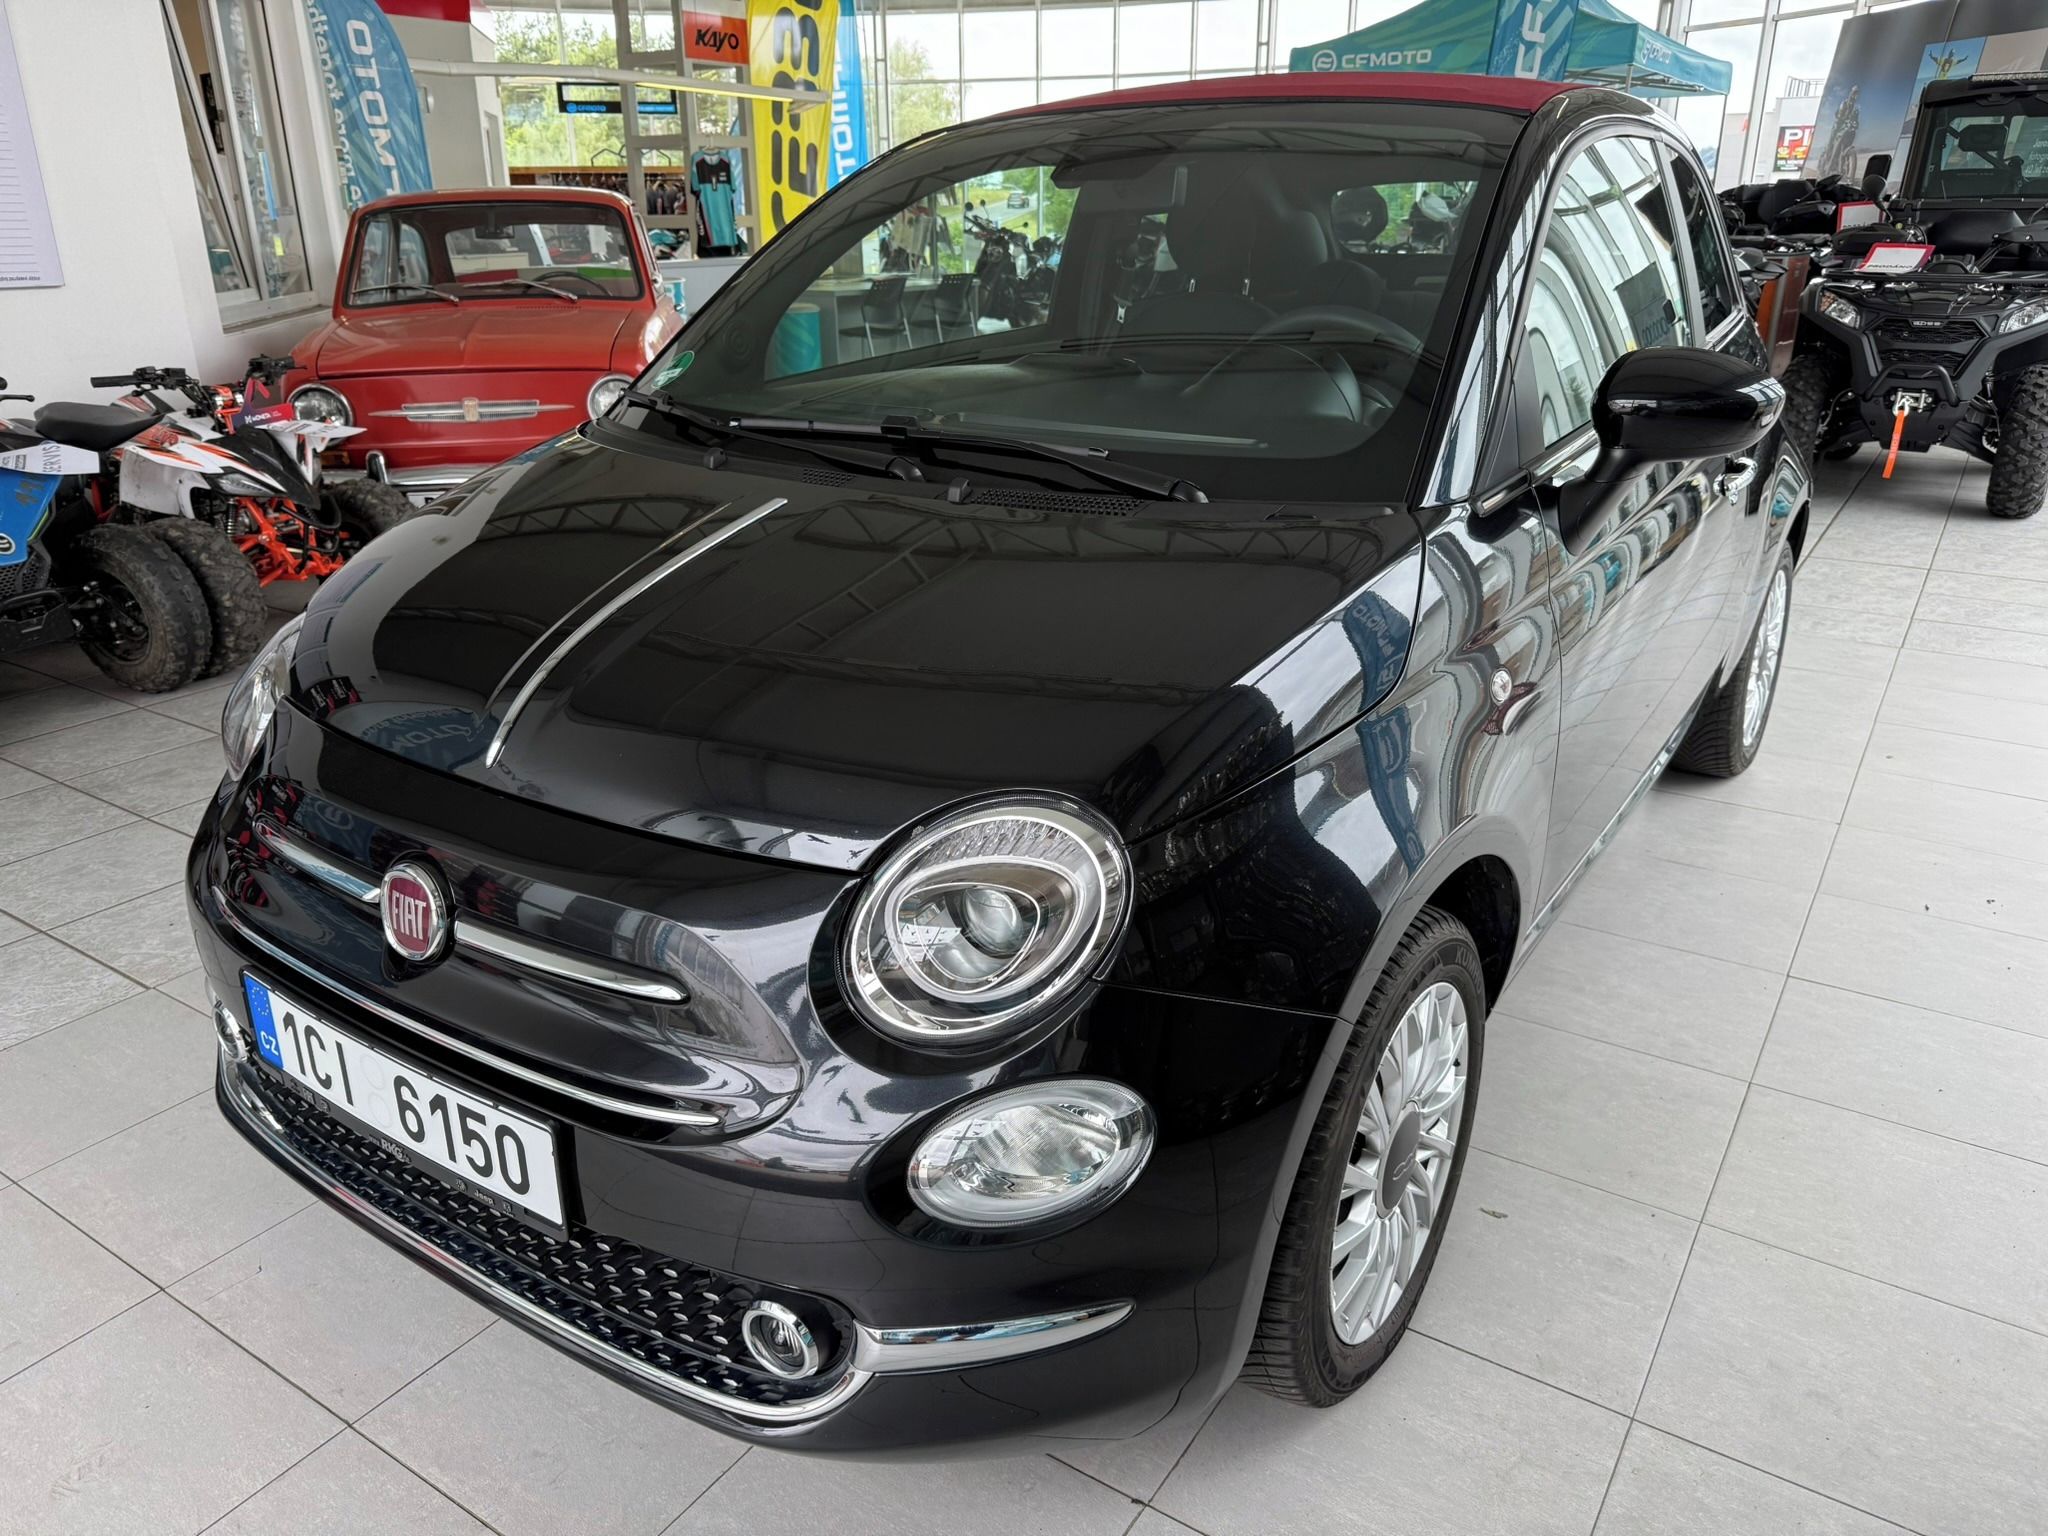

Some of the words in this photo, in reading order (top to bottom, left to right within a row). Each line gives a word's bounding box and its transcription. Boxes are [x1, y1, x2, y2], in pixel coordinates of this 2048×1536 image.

[695, 26, 739, 52] KAYO
[1341, 49, 1433, 69] CFMOTO
[391, 889, 427, 940] FIAT
[260, 1030, 279, 1057] CZ
[282, 1011, 354, 1106] 1CI
[393, 1074, 531, 1196] 6150
